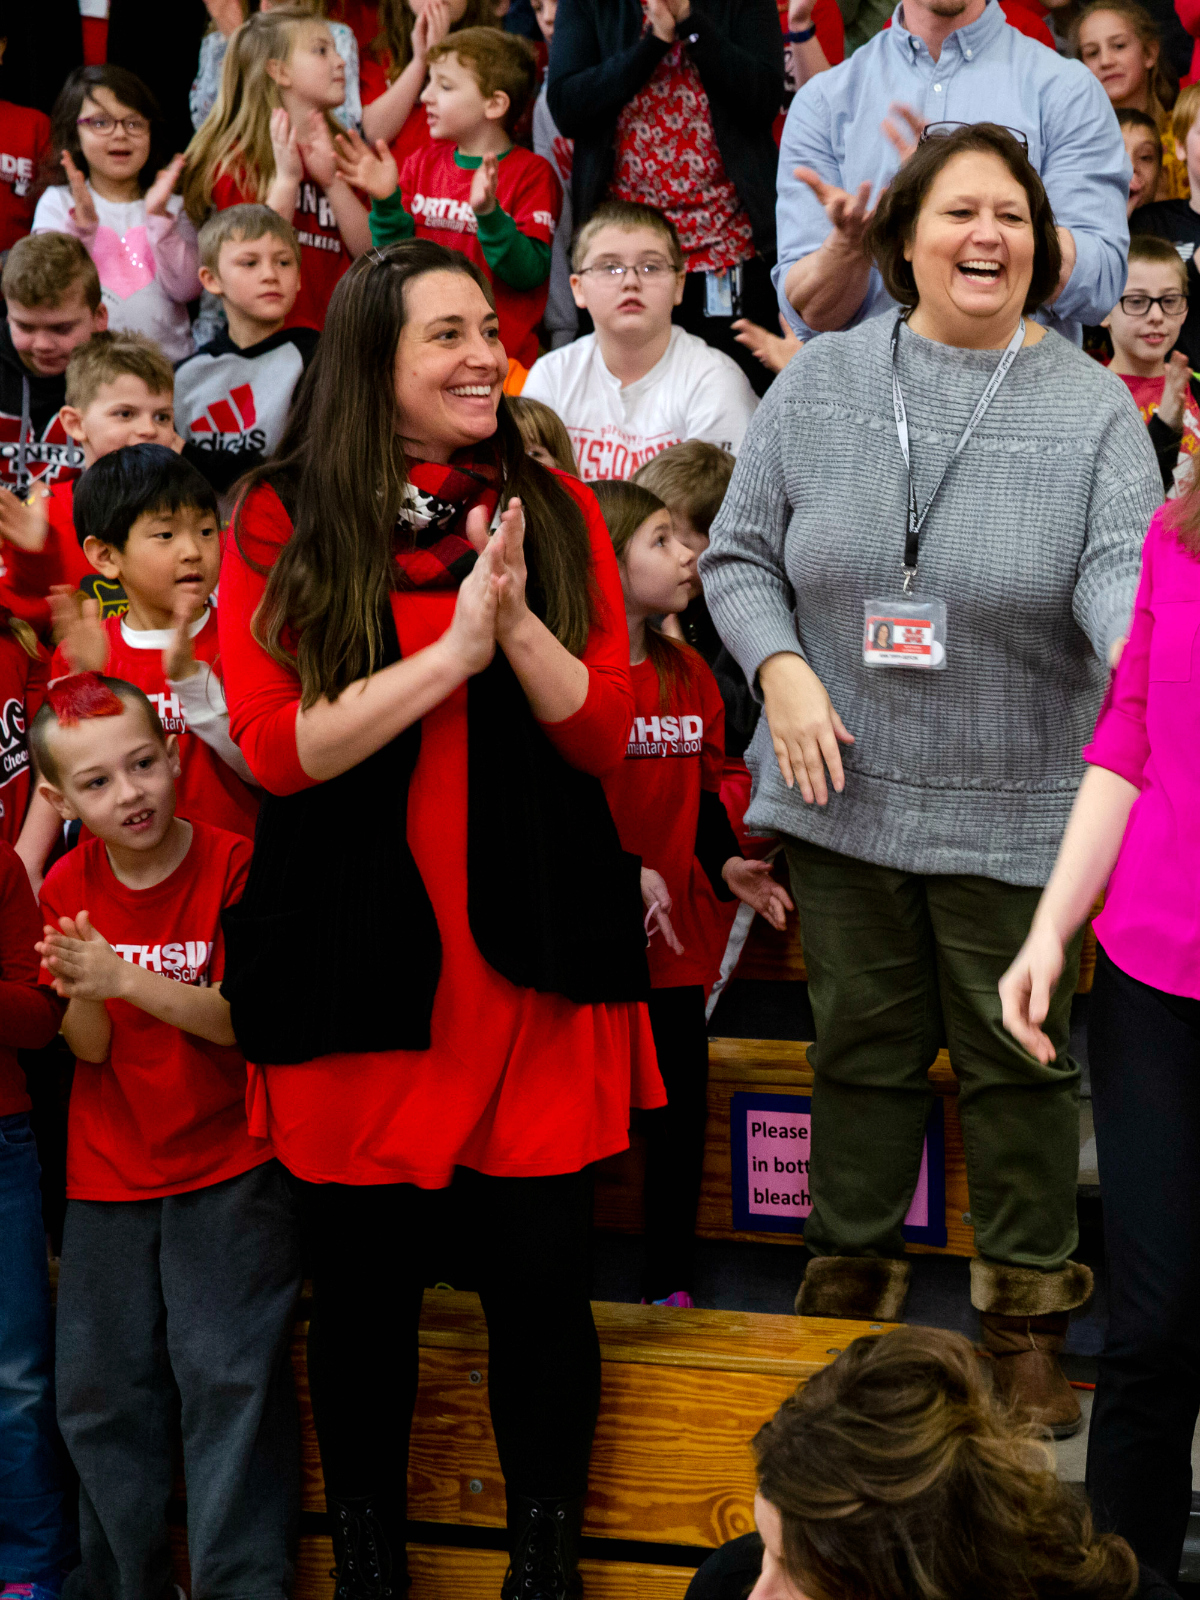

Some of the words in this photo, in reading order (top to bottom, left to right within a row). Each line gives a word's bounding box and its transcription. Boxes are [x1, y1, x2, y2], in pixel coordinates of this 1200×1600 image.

[0, 153, 33, 179] DE
[109, 941, 214, 972] THSID
[751, 1121, 809, 1140] Please
[752, 1156, 769, 1173] in
[774, 1157, 810, 1175] bott
[753, 1187, 811, 1207] bleach
